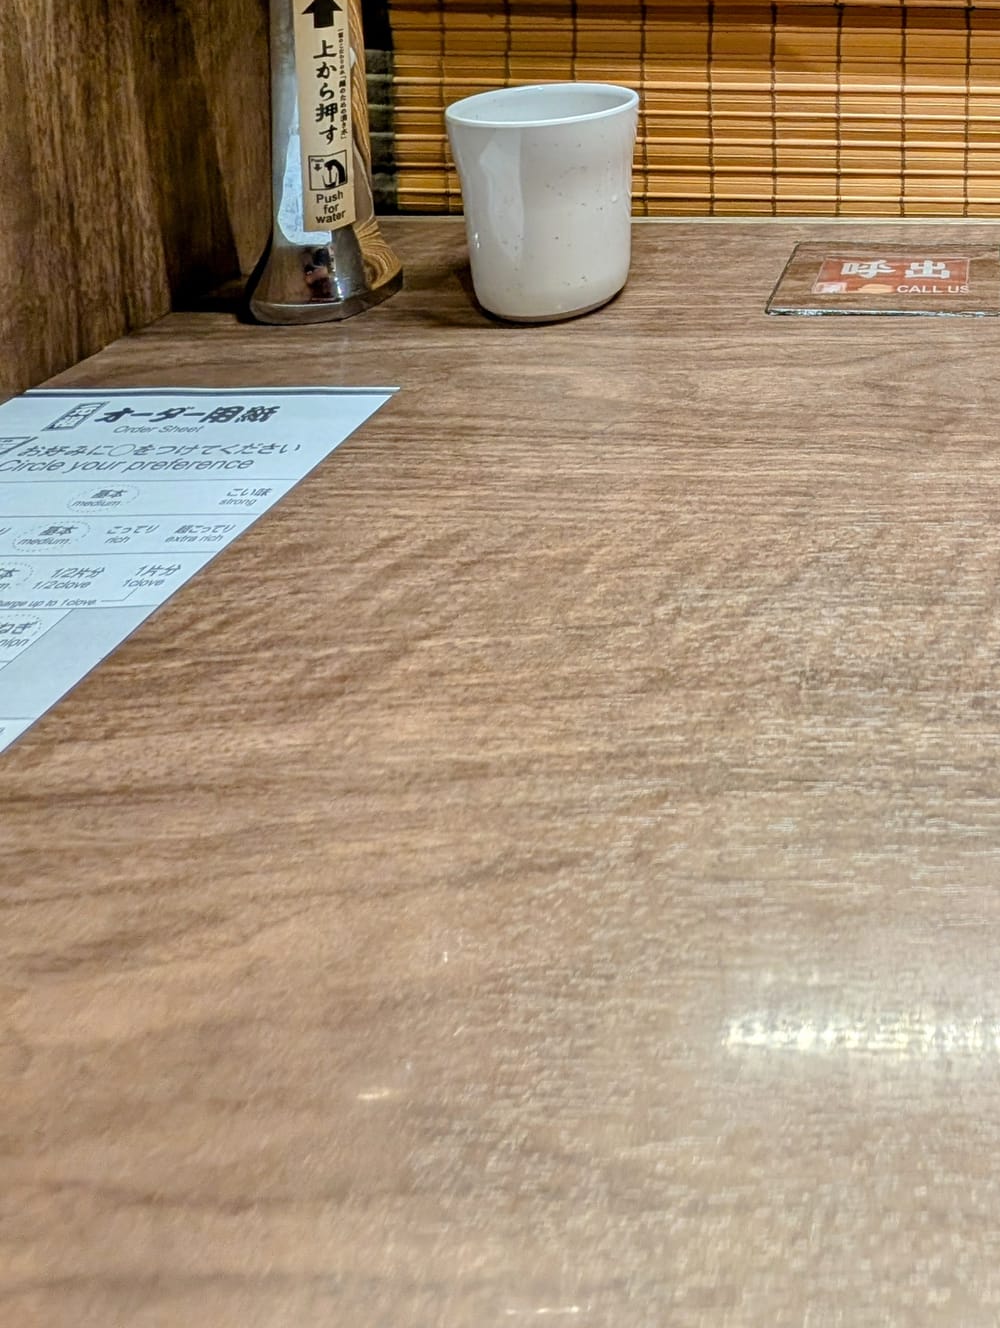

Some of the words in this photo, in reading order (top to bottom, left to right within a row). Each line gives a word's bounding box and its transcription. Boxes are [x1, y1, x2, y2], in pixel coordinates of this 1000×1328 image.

[313, 39, 340, 146] 上から押す
[316, 192, 344, 205] Push
[323, 202, 339, 214] for
[315, 211, 347, 225] water
[841, 258, 951, 279] 呼出
[897, 284, 942, 294] CALL
[947, 285, 970, 294] US
[95, 405, 281, 424] オーダー用紙
[113, 425, 157, 434] Order
[159, 424, 205, 434] Sheet
[62, 461, 123, 474] your
[121, 458, 254, 474] preference
[226, 487, 273, 497] こい味
[71, 499, 121, 507] medium
[218, 497, 258, 507] strong
[106, 524, 161, 535] こってり
[104, 535, 131, 544] rich
[164, 535, 197, 543] extra
[199, 534, 225, 543] rich
